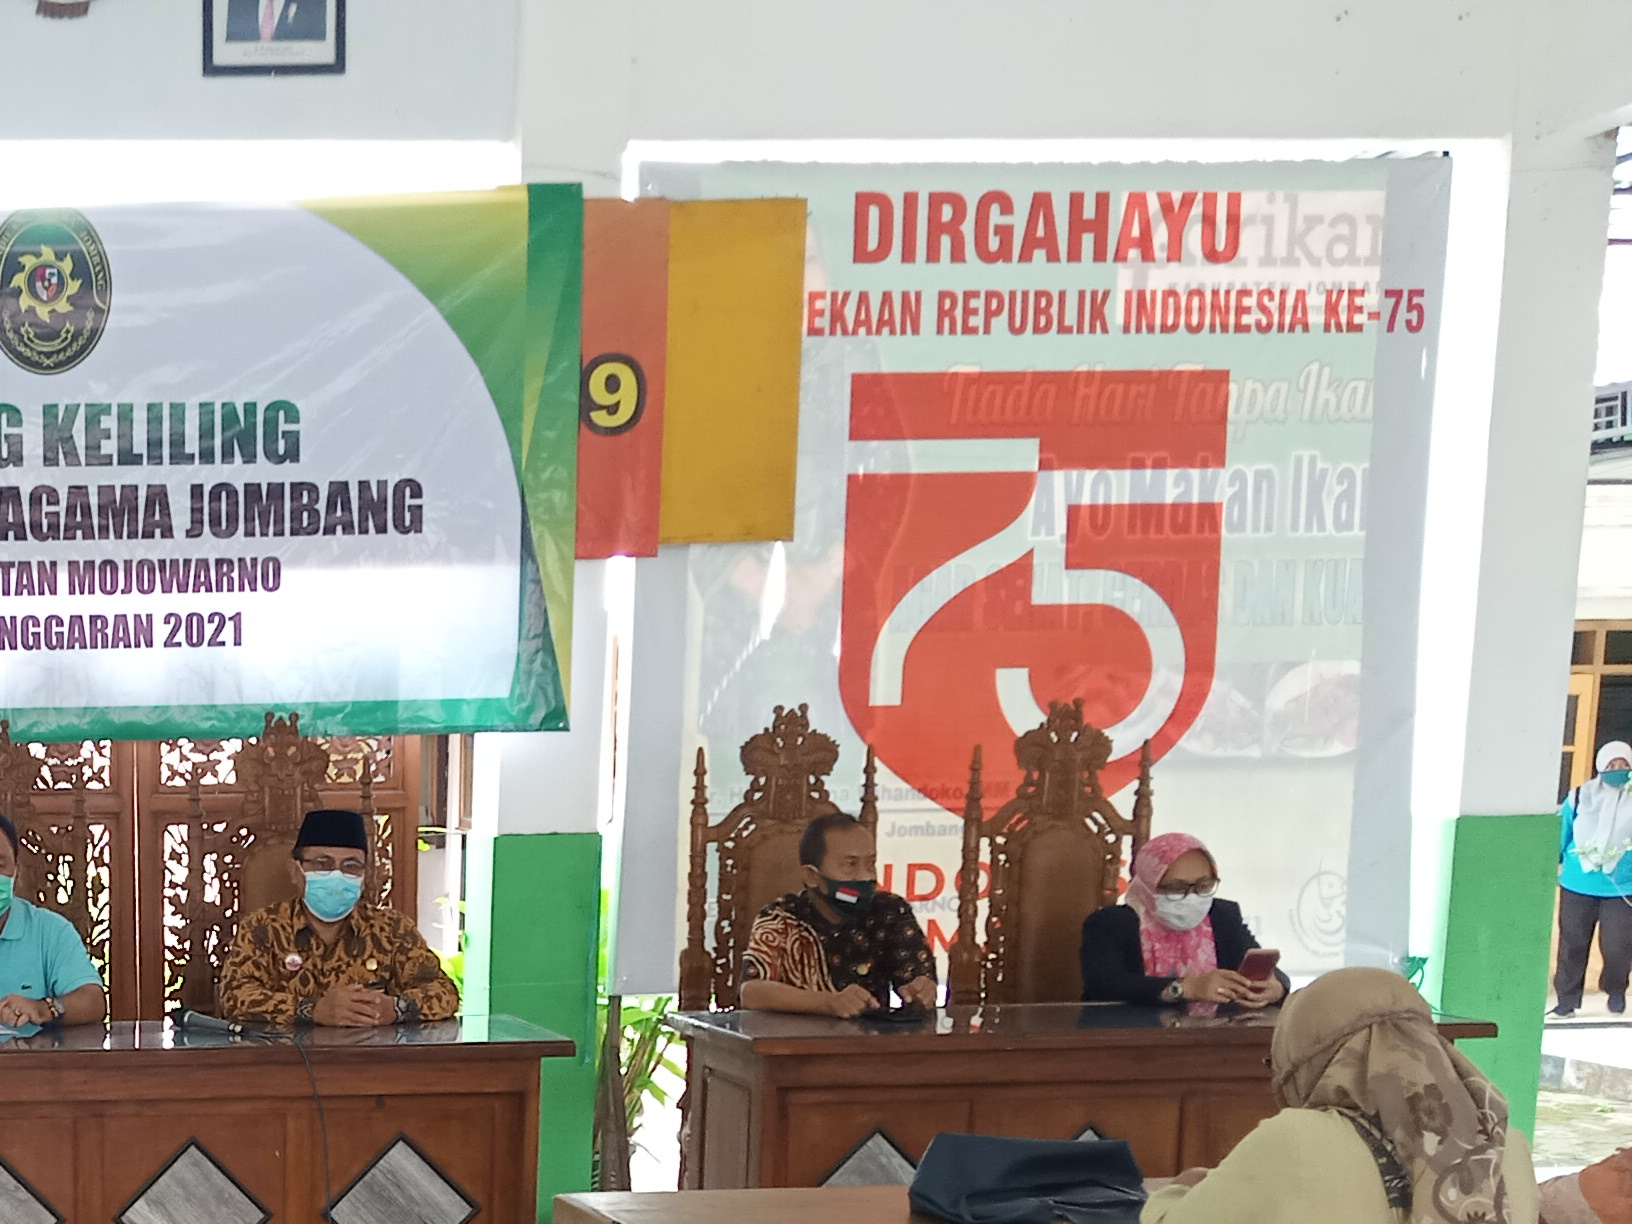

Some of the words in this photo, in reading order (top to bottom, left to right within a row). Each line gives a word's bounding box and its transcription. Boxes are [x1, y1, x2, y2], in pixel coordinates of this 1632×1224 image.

[853, 190, 1241, 263] DIRGAHAYU
[936, 290, 1110, 336] REPUBLIK
[1122, 288, 1310, 335] INDONESIA
[1323, 288, 1425, 334] KE-75
[1299, 359, 1374, 424] Ika
[42, 400, 300, 467] KELILING
[185, 478, 423, 539] JOMBANG
[1124, 452, 1278, 538] Makan
[68, 556, 281, 596] MOJOWARNO
[163, 612, 242, 648] 2021
